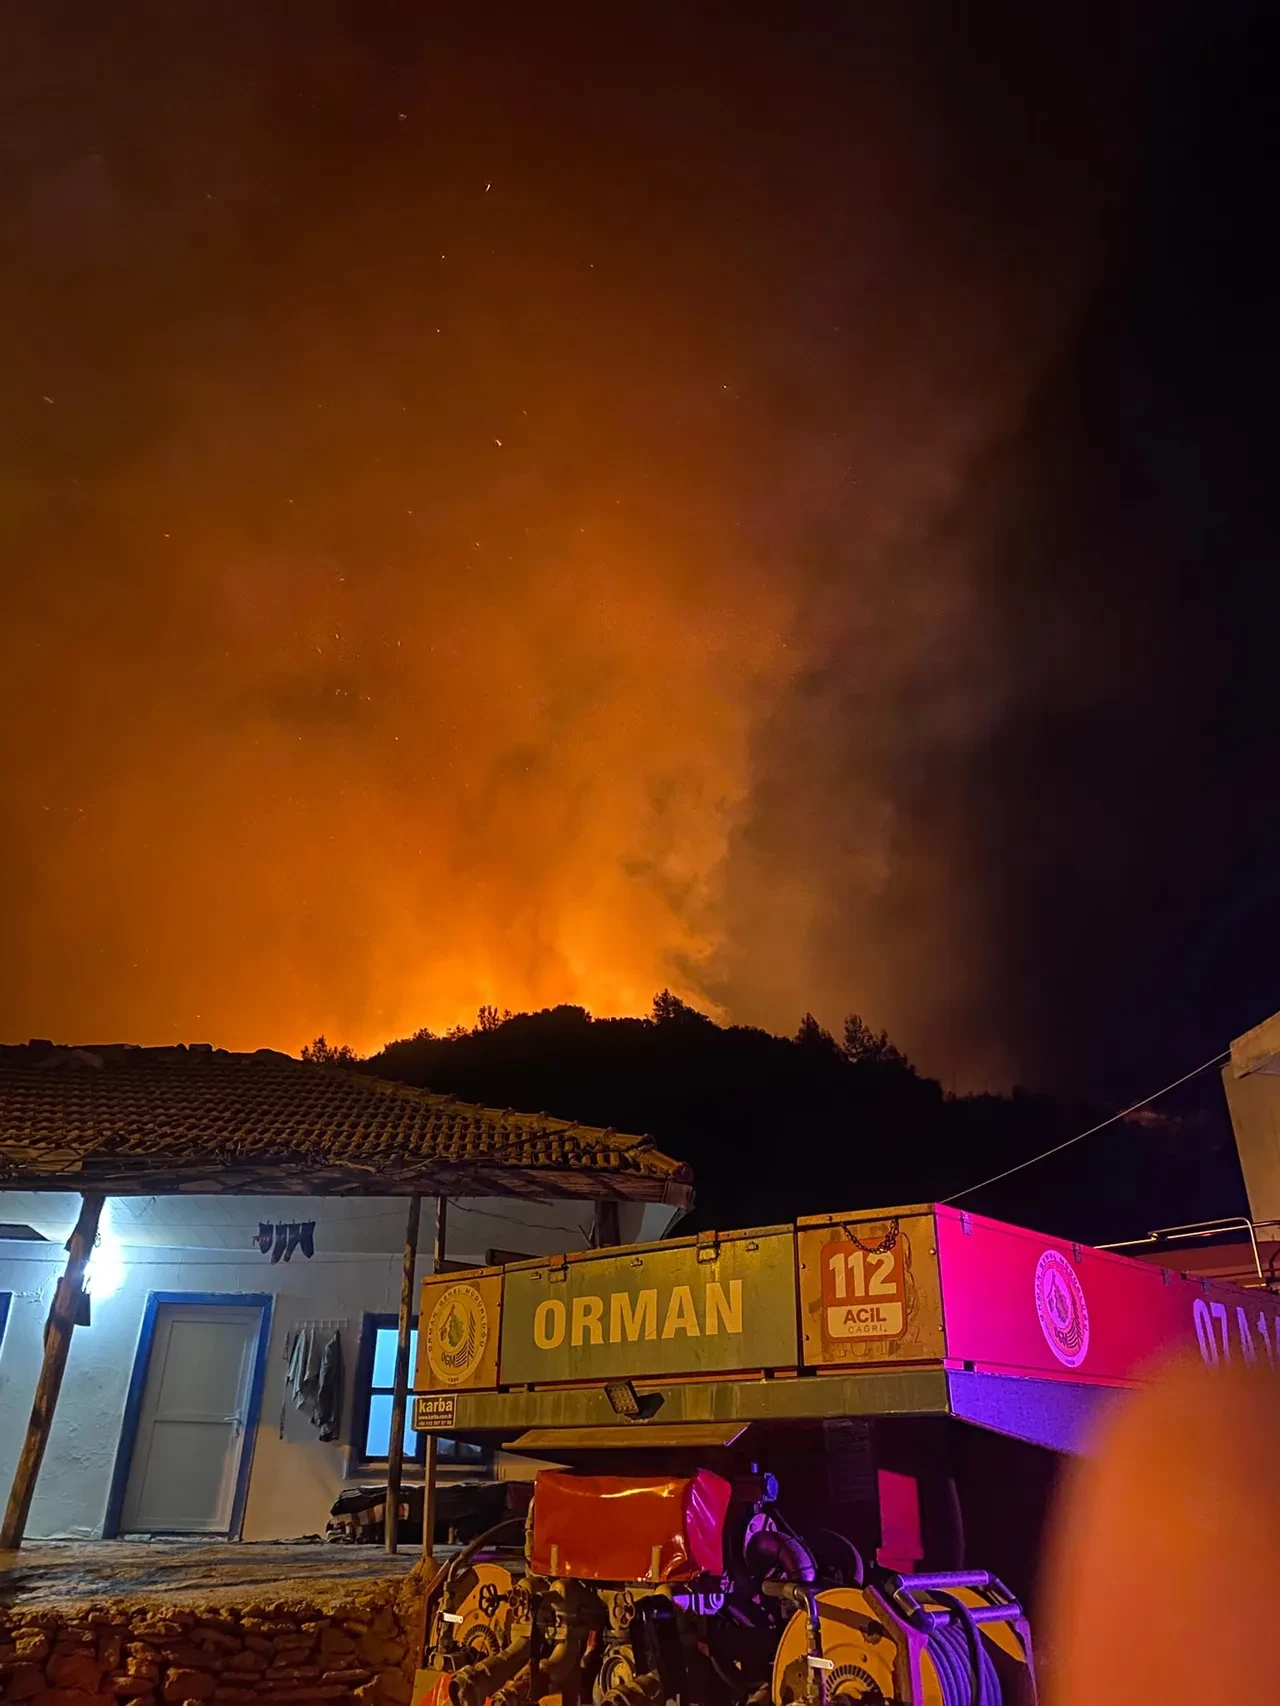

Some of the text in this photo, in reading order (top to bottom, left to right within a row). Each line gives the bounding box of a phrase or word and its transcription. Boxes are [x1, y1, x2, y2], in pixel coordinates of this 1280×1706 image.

[829, 1251, 897, 1299] 112
[428, 1311, 438, 1352] ORMAN
[438, 1287, 461, 1307] GENEL
[533, 1278, 743, 1350] ORMAN
[441, 1352, 456, 1368] OGM
[419, 1397, 453, 1413] karba
